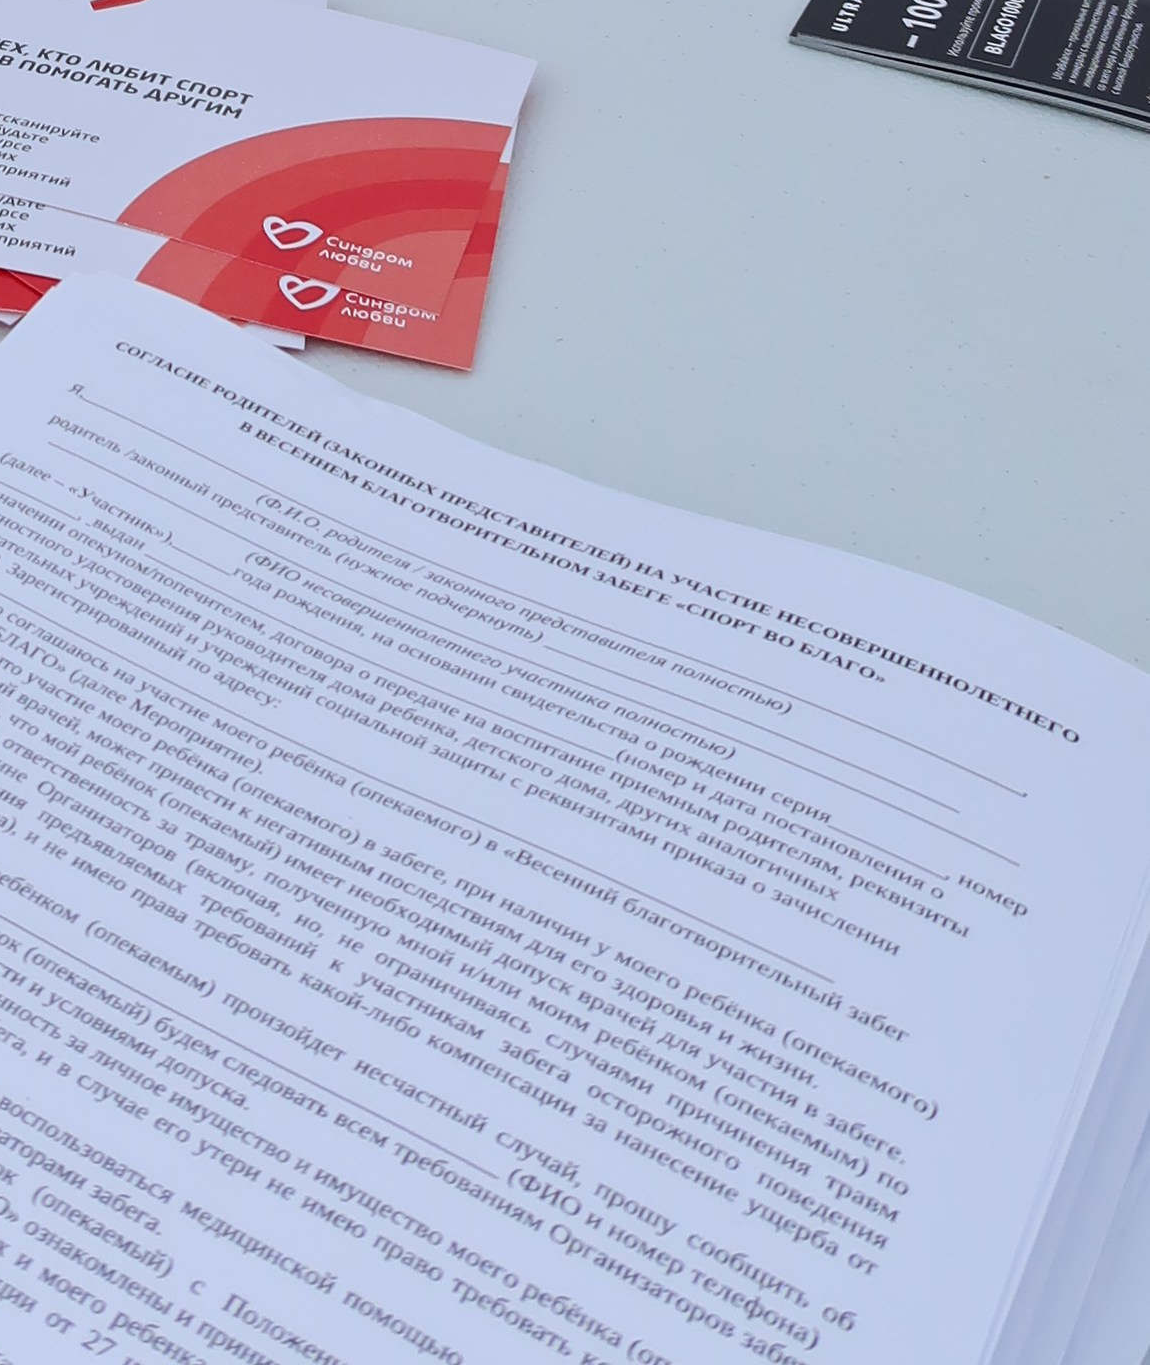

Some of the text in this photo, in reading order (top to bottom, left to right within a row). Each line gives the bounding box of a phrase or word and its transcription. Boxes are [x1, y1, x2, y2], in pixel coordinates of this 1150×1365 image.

[17, 59, 138, 94] ПОМОГАТЬ
[142, 88, 242, 119] ДРУГИМ
[36, 48, 81, 65] КТО
[84, 59, 172, 85] ЛЮБИТ
[176, 79, 253, 105] СПОРТ
[318, 249, 381, 272] любви
[326, 236, 412, 268] Синдром
[340, 306, 405, 327] любви
[345, 292, 439, 321] Синдром
[46, 414, 121, 453] родитель
[210, 492, 332, 556] представитель
[334, 552, 413, 591] (нужное
[415, 587, 544, 643] подчеркнуть)
[115, 341, 1080, 743] СОГЛАСИЕ РОДИТЕЛЕЙ (ЗАКОННЫХ ПРЕДСТАВИТЕЛЕЙ) НА УЧАСТИЕ НЕСОВЕРШЕННОЛЕТНЕГО
[238, 420, 886, 683] В ВЕСЕННЕМ БЛАГОТВОРИТЕЛЬНОМ ЗАБЕГЕ «СПОРТ ВО БЛАГО»
[255, 494, 516, 611] (Ф.И.О. родителя законного
[0, 452, 766, 796] (далее рождения, свидетельства о рождении
[8, 713, 39, 736] что
[41, 732, 82, 757] мой
[15, 693, 81, 735] врачей,
[499, 664, 736, 760] участника полностью)
[428, 744, 747, 886] защиты реквизитами приказа
[461, 736, 840, 901] детского дома, других аналогичных
[608, 770, 843, 881] приемным родителям,
[352, 1059, 678, 1237] несчастный случай, прошу
